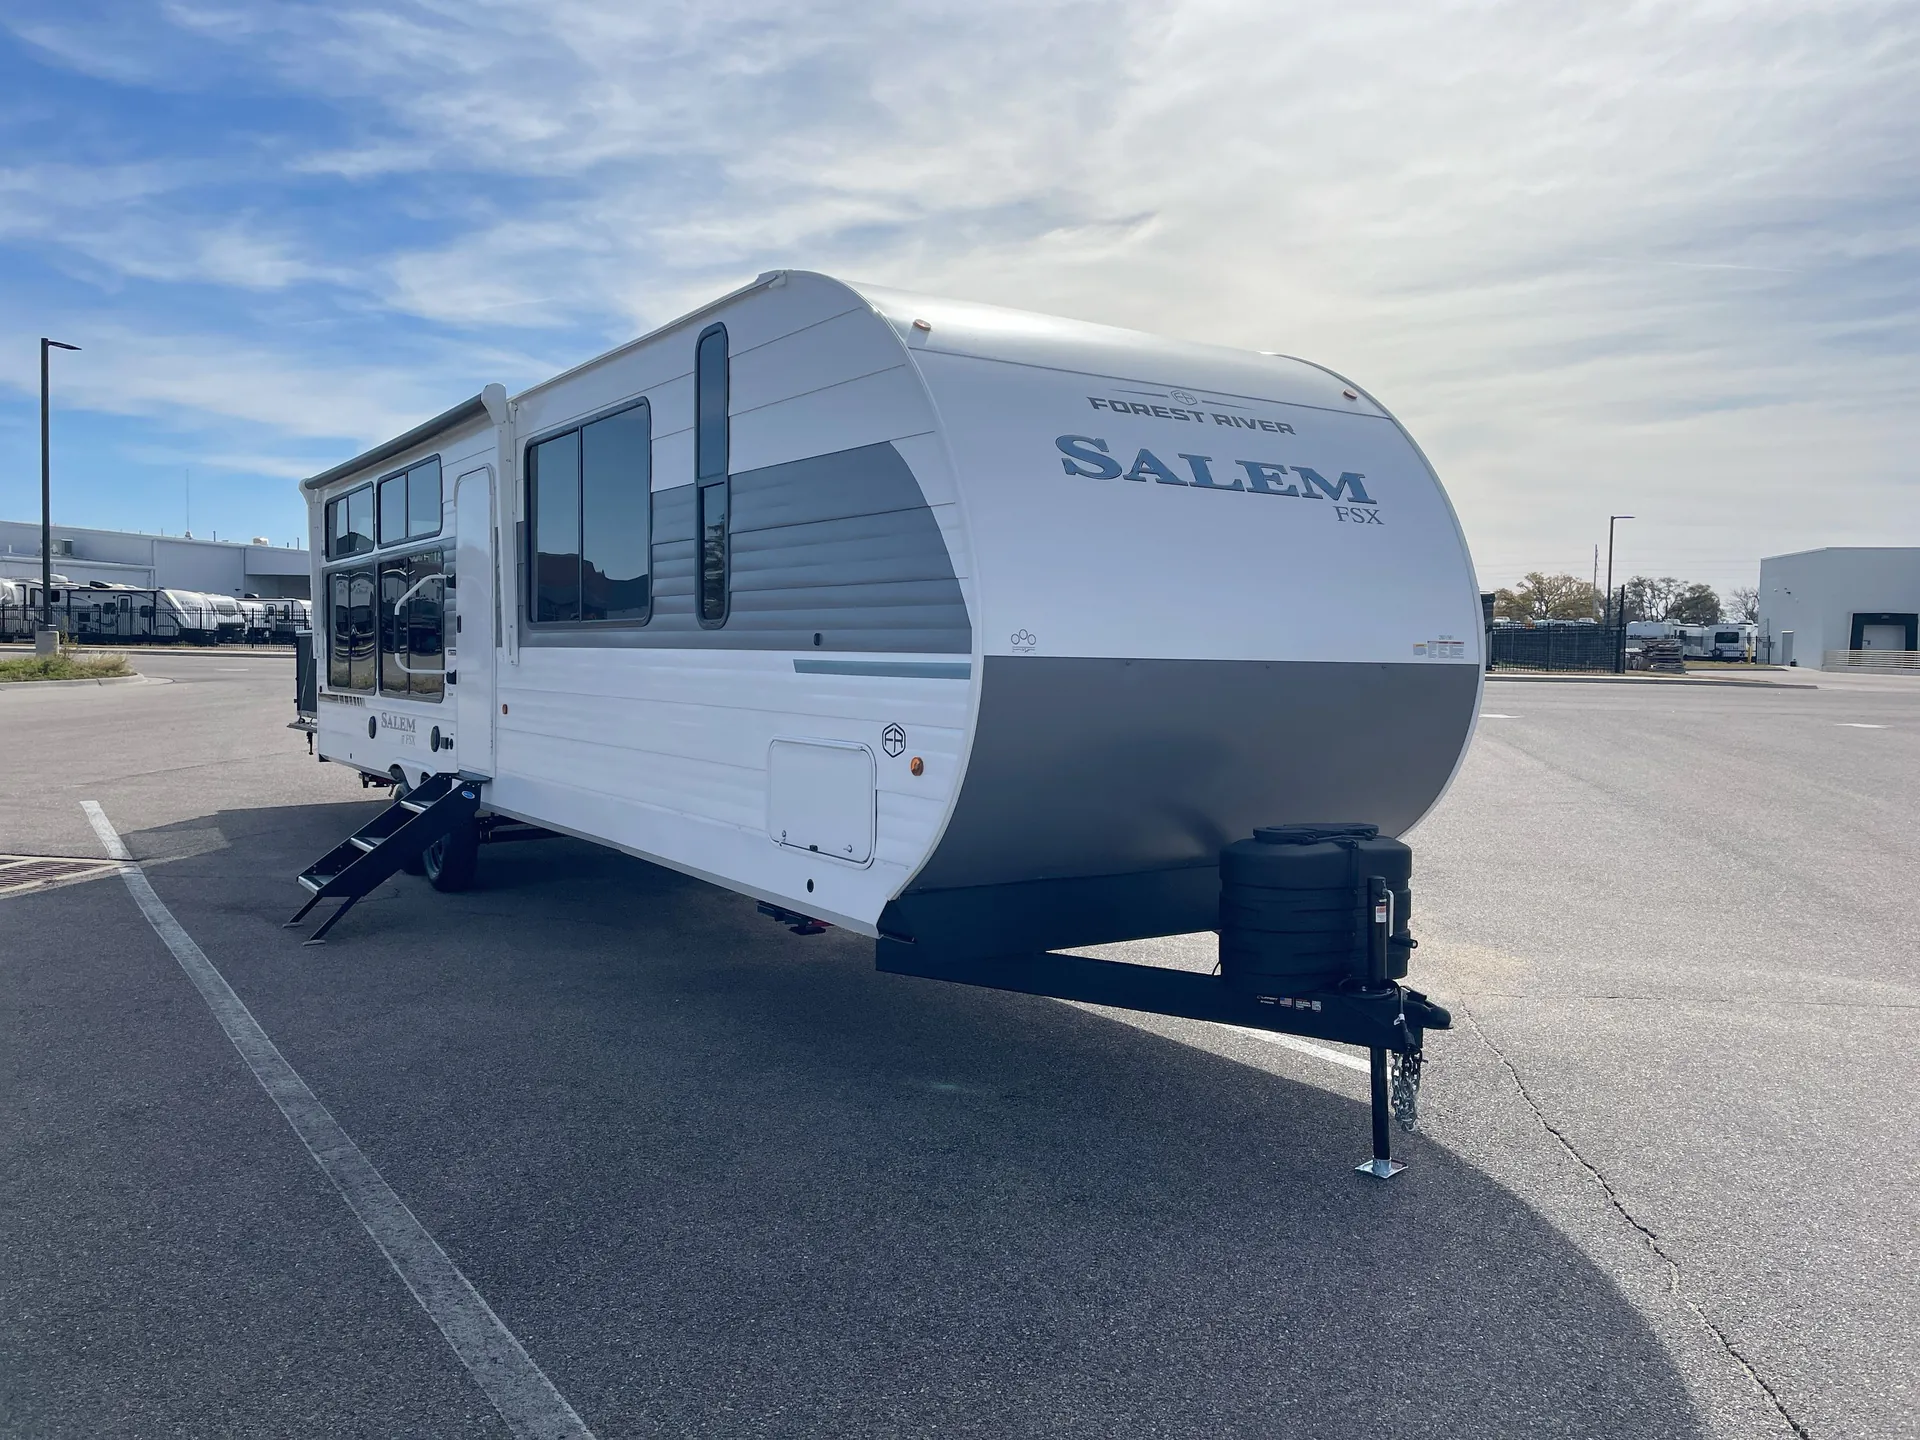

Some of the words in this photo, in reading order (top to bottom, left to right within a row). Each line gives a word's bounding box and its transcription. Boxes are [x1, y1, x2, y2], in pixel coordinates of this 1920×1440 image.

[1086, 396, 1204, 424] FOREST
[1209, 412, 1297, 435] RIVER
[1055, 434, 1378, 505] SALEM
[1332, 505, 1385, 526] FSX
[381, 711, 416, 733] SALEM
